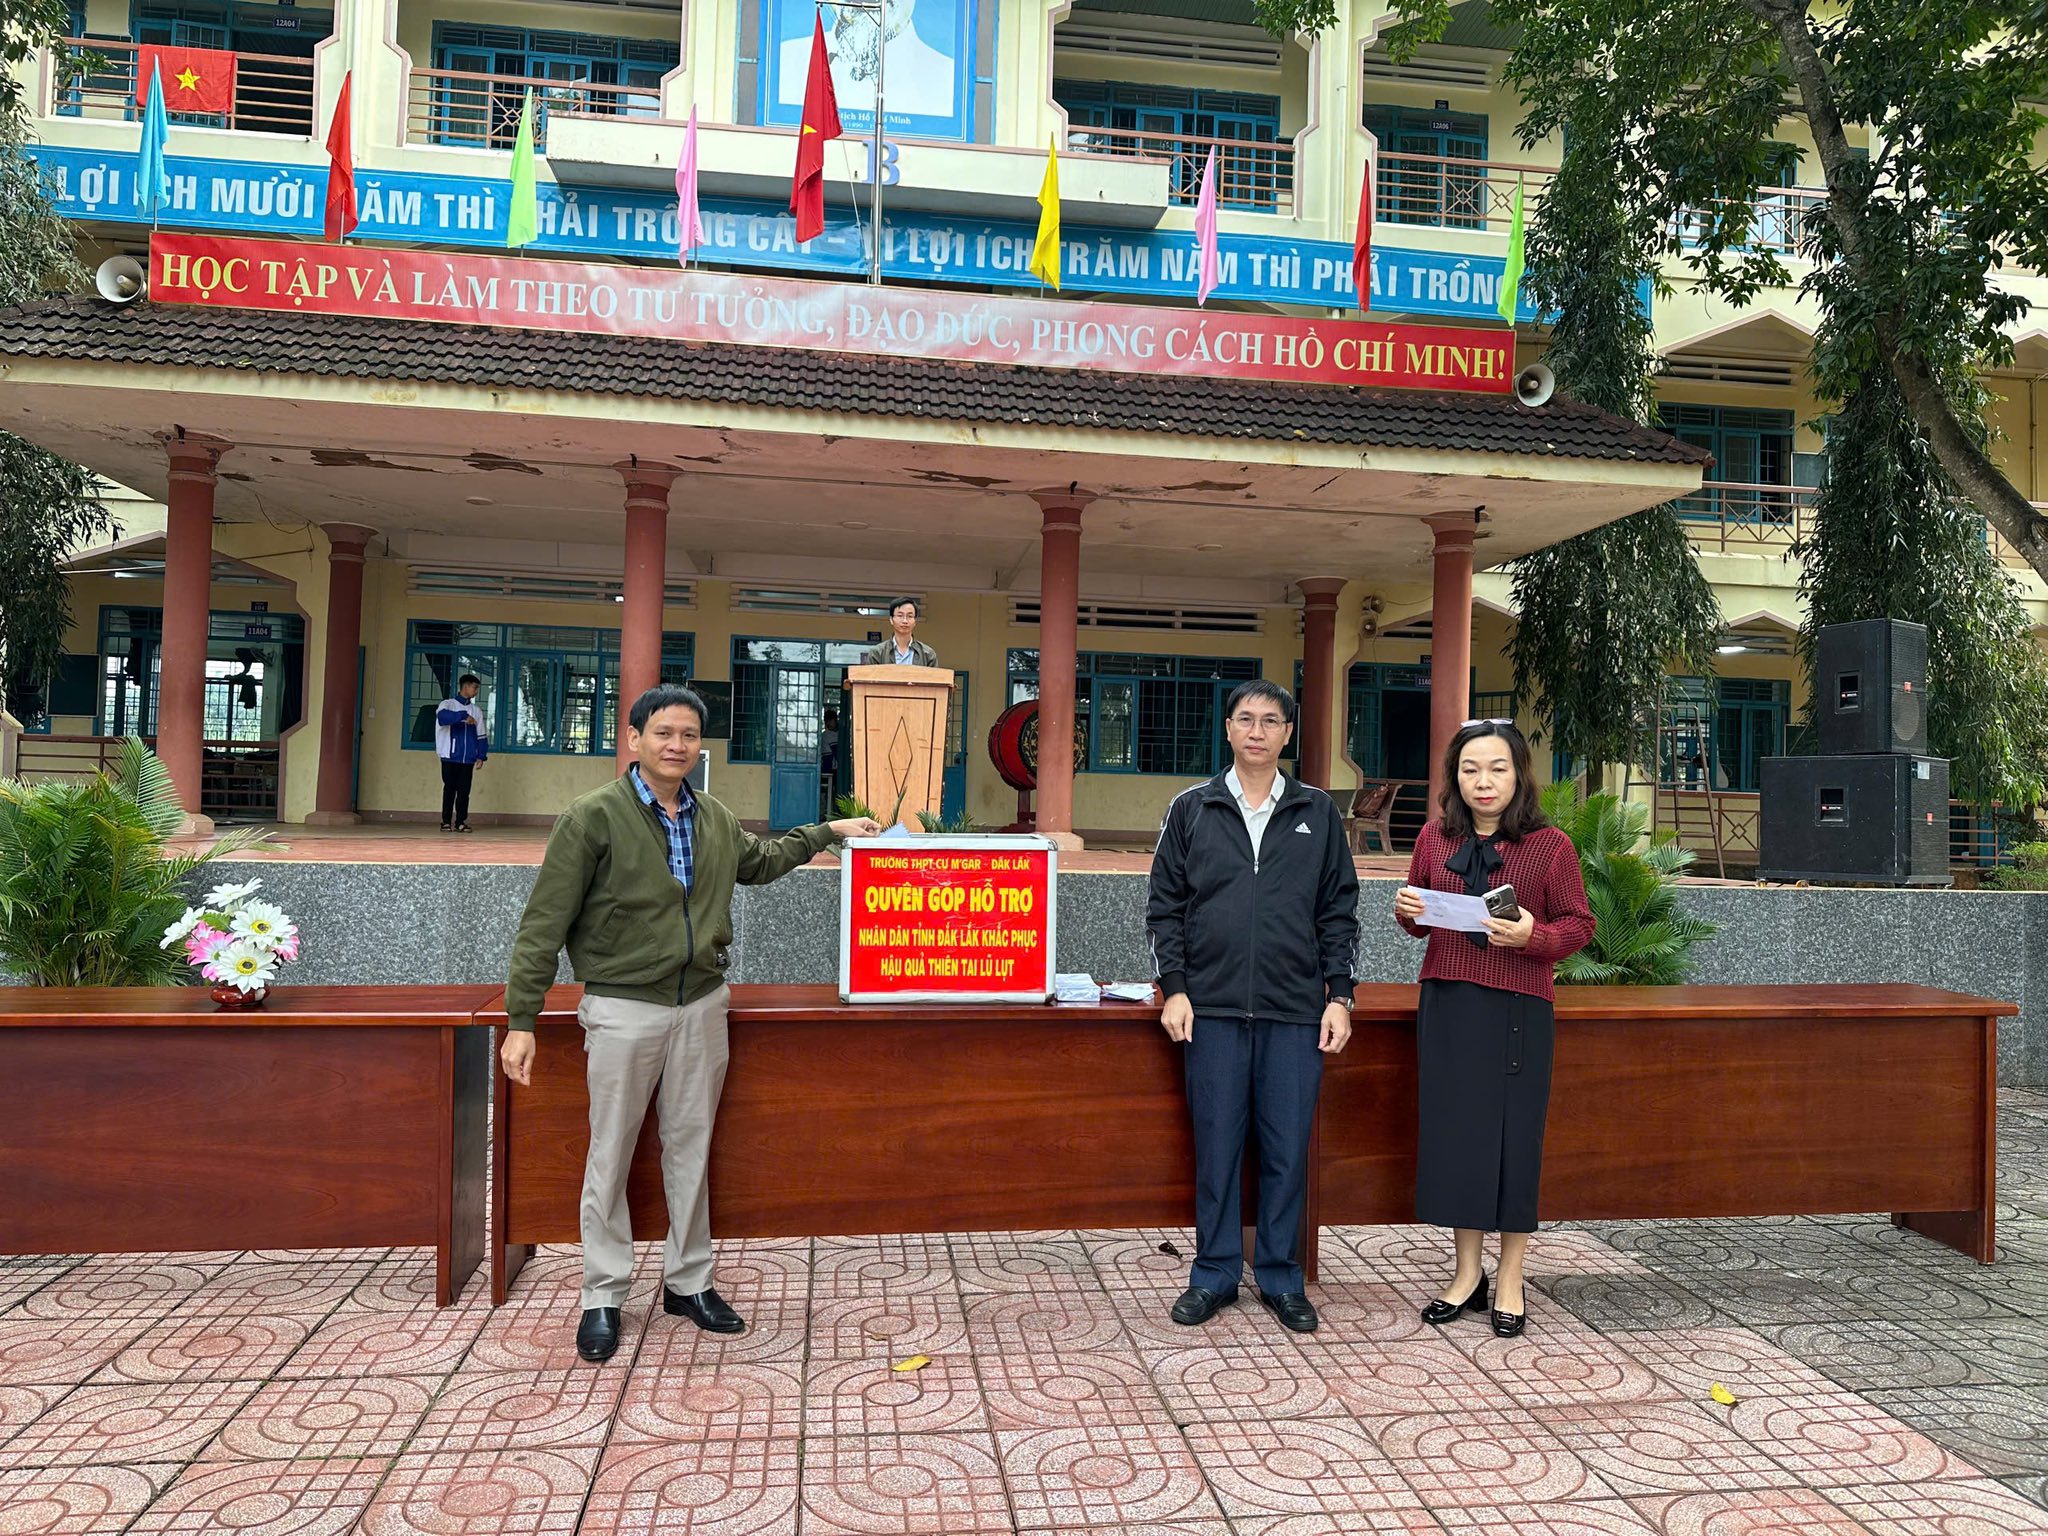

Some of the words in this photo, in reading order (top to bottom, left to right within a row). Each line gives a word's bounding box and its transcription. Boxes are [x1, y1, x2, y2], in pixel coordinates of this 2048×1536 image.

[890, 116, 912, 125] Minh
[863, 139, 900, 186] B
[57, 163, 119, 211] LỢI
[211, 170, 314, 219] MƯỜI
[354, 181, 421, 225] ĂM
[434, 187, 495, 230] THÌ
[536, 191, 598, 238] HẢI
[909, 227, 964, 272] LỢI
[976, 227, 1035, 272] ÍCH
[1248, 248, 1300, 289] THÌ
[160, 253, 249, 299] HỌC
[260, 257, 338, 306] TẬP
[345, 259, 401, 304] VÀ
[411, 264, 500, 311] LÀM
[510, 279, 618, 318] THEO
[627, 286, 684, 323] TƯ
[690, 287, 834, 342] TƯỞNG,
[846, 304, 925, 349] ĐẠO
[934, 304, 1021, 355] ĐỨC,
[1031, 318, 1156, 358] PHONG
[1165, 320, 1263, 365] CÁCH
[1273, 327, 1324, 369] HỒ
[1333, 332, 1396, 373] CHÍ
[1404, 342, 1506, 380] MINH!
[870, 856, 908, 869] TRƯỜNG
[911, 858, 934, 870] THPT
[935, 857, 949, 870] CƯ
[951, 858, 981, 870] M'GAR
[865, 881, 923, 913] QUYÊN
[969, 878, 995, 912] HỖ
[999, 885, 1033, 916] TRỢ
[859, 924, 887, 946] NHÂN
[889, 924, 910, 946] DÂN
[912, 921, 935, 946] TỈNH
[937, 921, 958, 946] ĐẮK
[960, 921, 979, 947] LẮK
[982, 921, 1009, 947] KHẮC
[1010, 929, 1037, 953] PHỤC
[881, 954, 902, 981] HẬU
[904, 951, 925, 977] QUẢ
[928, 955, 958, 976] THIÊN
[961, 959, 977, 976] TAI
[980, 953, 993, 976] LŨ
[995, 959, 1015, 982] LỤT
